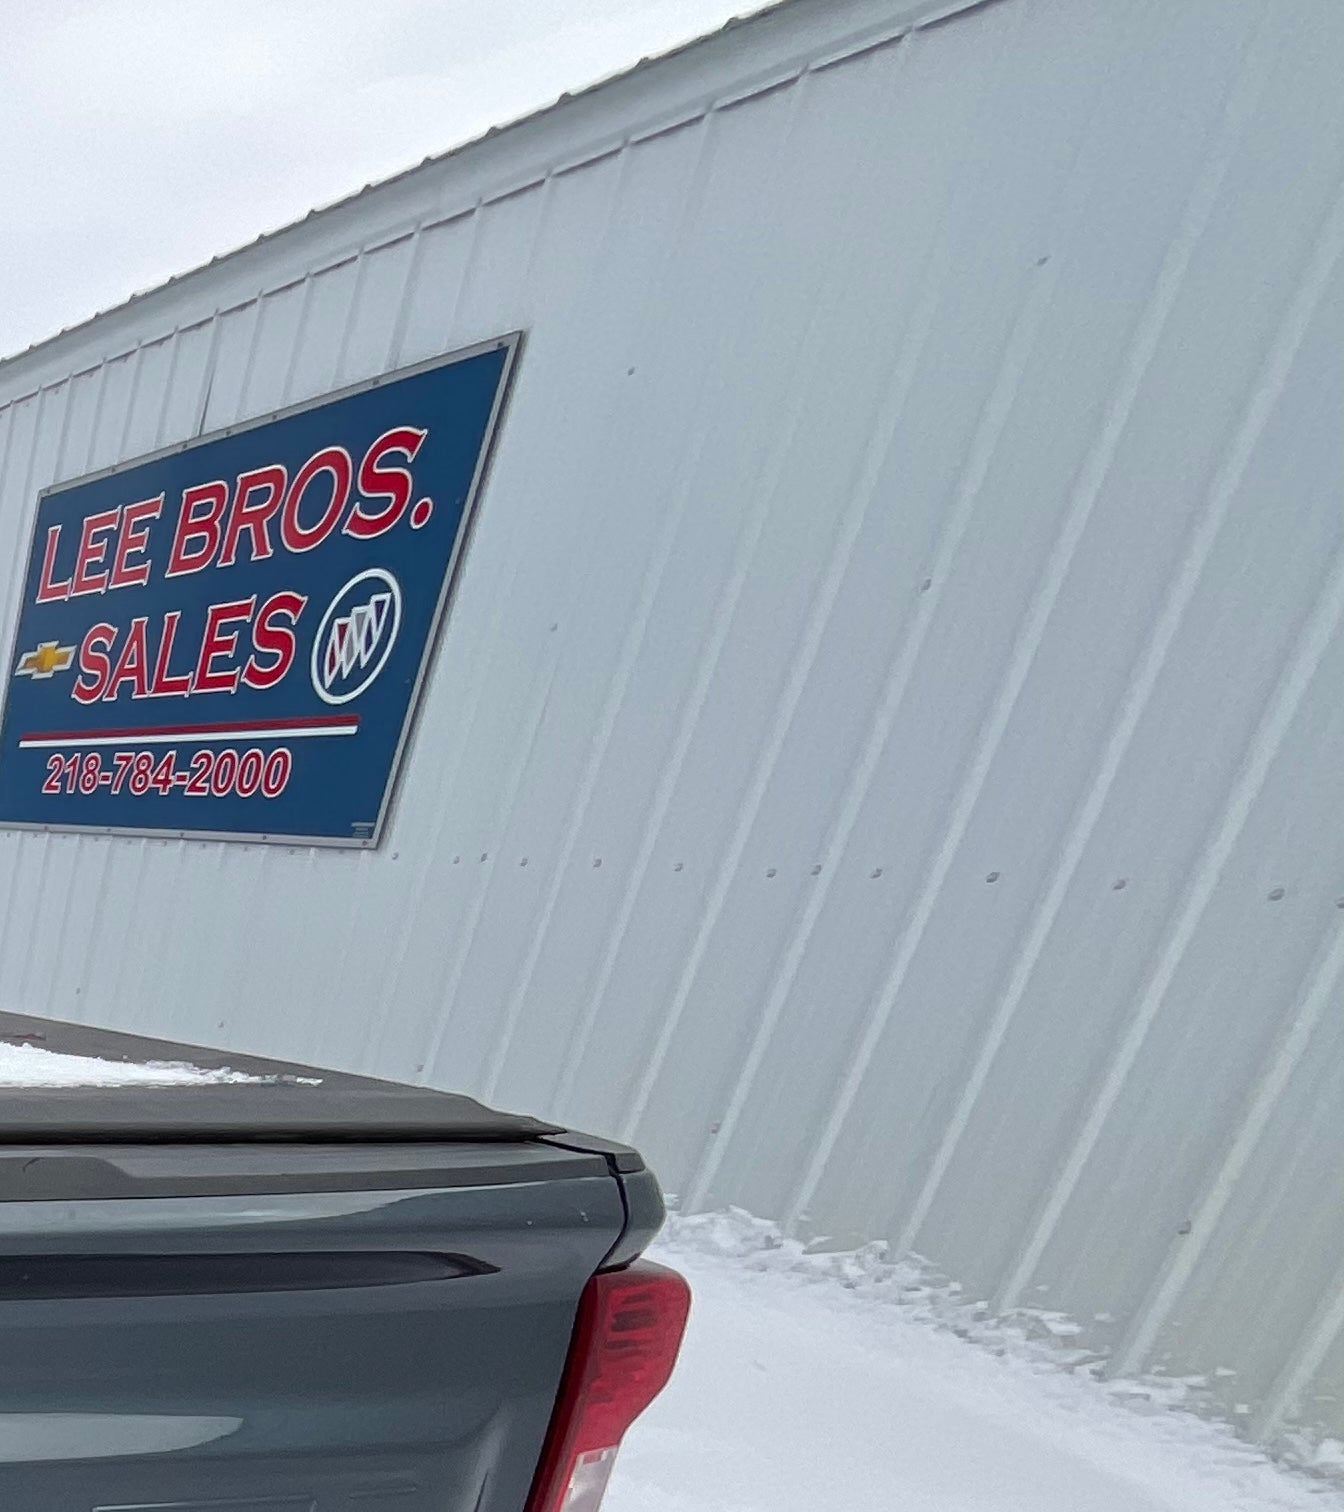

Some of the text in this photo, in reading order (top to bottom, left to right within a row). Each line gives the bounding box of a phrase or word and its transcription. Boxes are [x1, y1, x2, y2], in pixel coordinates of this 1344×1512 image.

[36, 426, 434, 604] LEE BROS.
[71, 590, 308, 704] SALES
[42, 747, 292, 799] 218-784-2000
